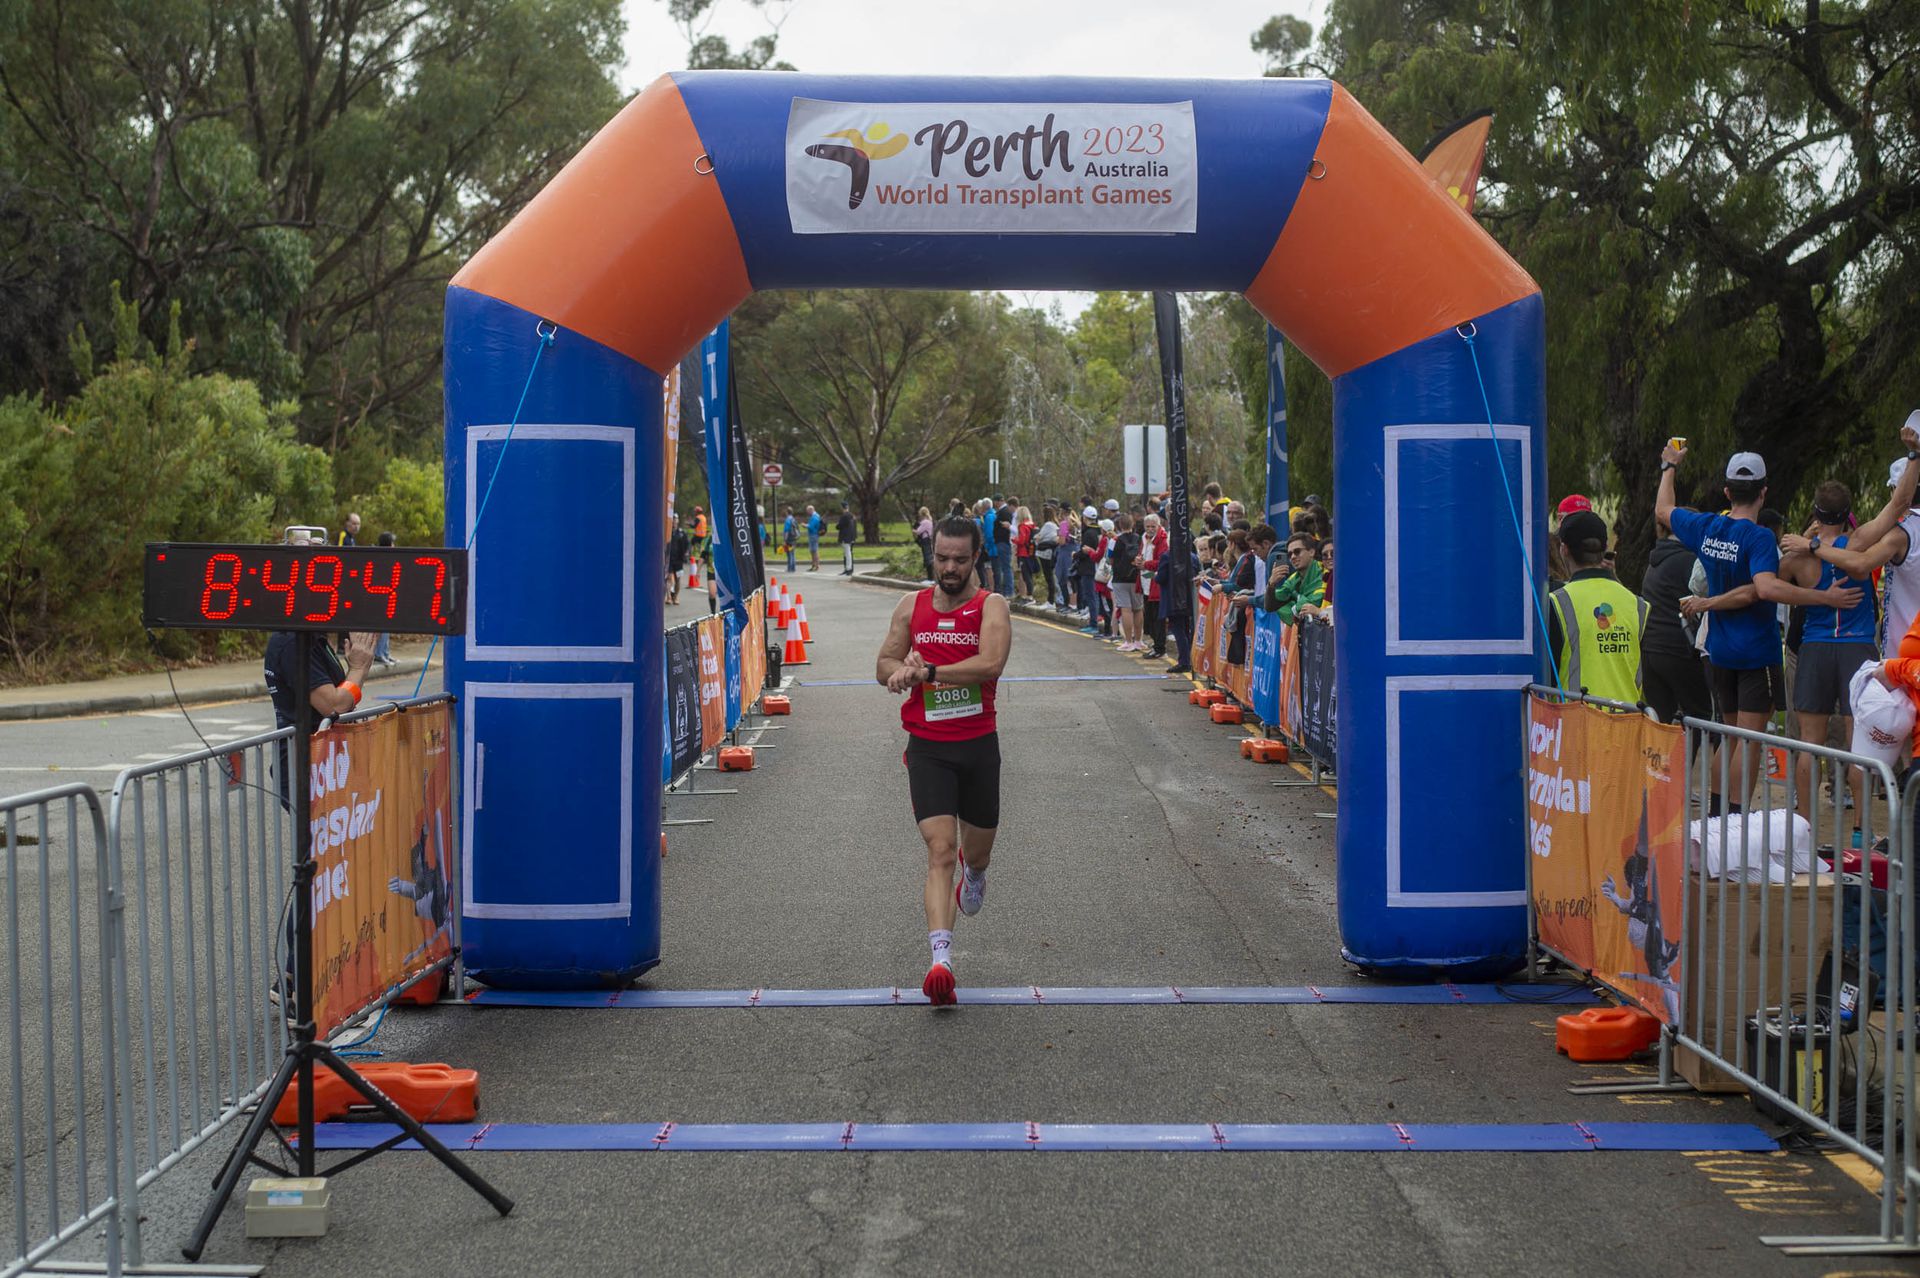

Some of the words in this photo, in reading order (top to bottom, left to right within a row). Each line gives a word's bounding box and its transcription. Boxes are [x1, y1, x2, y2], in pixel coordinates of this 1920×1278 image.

[914, 113, 1075, 181] Perth
[1082, 123, 1166, 157] 2023
[1084, 161, 1169, 178] Australia
[875, 184, 949, 205] World
[957, 184, 1084, 209] Transplant
[1091, 184, 1173, 205] Games
[1597, 632, 1631, 642] event
[1599, 643, 1629, 653] team
[934, 688, 970, 703] 3080
